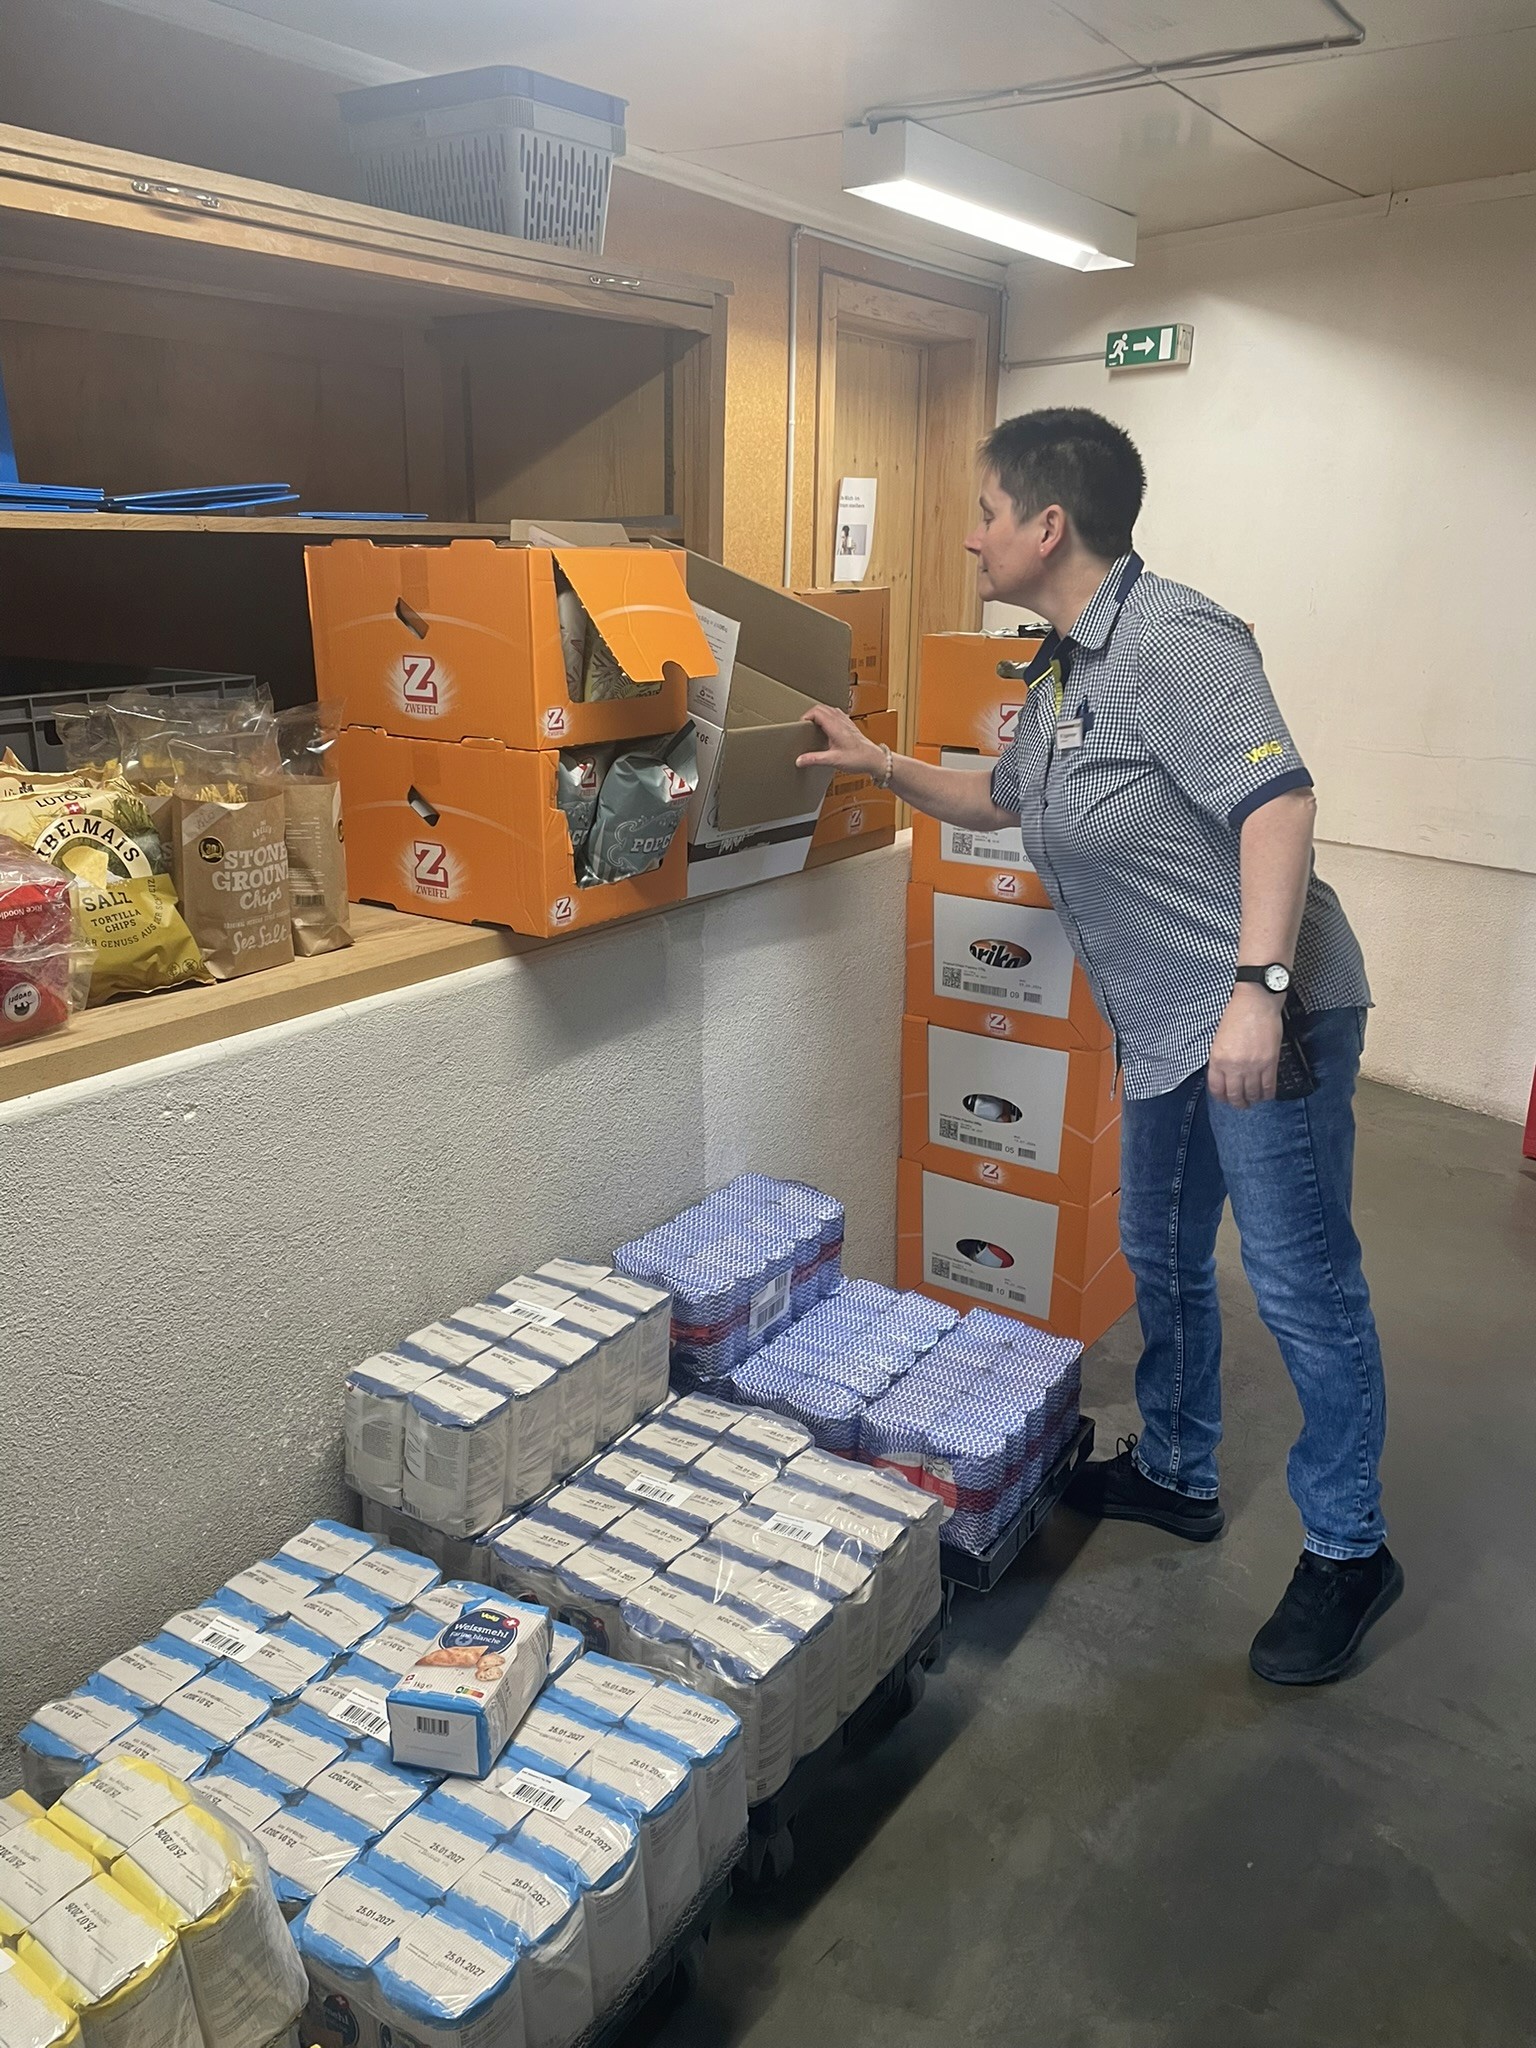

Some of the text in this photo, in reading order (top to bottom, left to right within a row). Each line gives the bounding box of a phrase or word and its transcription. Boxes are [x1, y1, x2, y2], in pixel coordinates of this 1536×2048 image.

[403, 655, 438, 703] Z
[404, 702, 439, 716] ZWEIFEL
[548, 707, 564, 730] Z
[1245, 740, 1283, 763] Volg
[630, 835, 673, 853] POPC
[224, 841, 288, 870] STONE
[413, 840, 448, 888] Z
[211, 860, 289, 892] GROUN
[997, 874, 1015, 892] Z
[82, 891, 133, 912] SALZ
[239, 887, 282, 914] Chips
[415, 884, 449, 900] ZWEIFEL
[26, 904, 43, 914] Rice
[90, 909, 142, 927] TORTILLA
[556, 897, 572, 920] Z
[101, 935, 139, 948] GENUSS
[141, 923, 157, 938] AUS
[105, 919, 137, 933] CHIPS
[257, 924, 289, 948] Salt
[1009, 991, 1020, 999] 09
[989, 1012, 1006, 1031] Z
[982, 1162, 999, 1180] Z
[996, 1287, 1005, 1296] 10
[480, 1611, 500, 1622] Volg
[454, 1623, 509, 1639] Weissmehl
[473, 1633, 501, 1645] blanche
[601, 1680, 636, 1697] 25.01.2027
[682, 1707, 720, 1726] 25.01.2027
[548, 1725, 585, 1743] 25.01.2027
[328, 1771, 362, 1792] 25.01.2027
[155, 1828, 188, 1859] 25.07.2026
[262, 1826, 297, 1848] 25.01.2027
[574, 1824, 612, 1854] 25.01.2027
[429, 1842, 465, 1865] 25.01.2027
[511, 1878, 551, 1909] 25.01.2027
[65, 1902, 97, 1932] 25.07.2026
[355, 1905, 396, 1928] 25.01.2027
[444, 1951, 486, 1978] 25.01.2027
